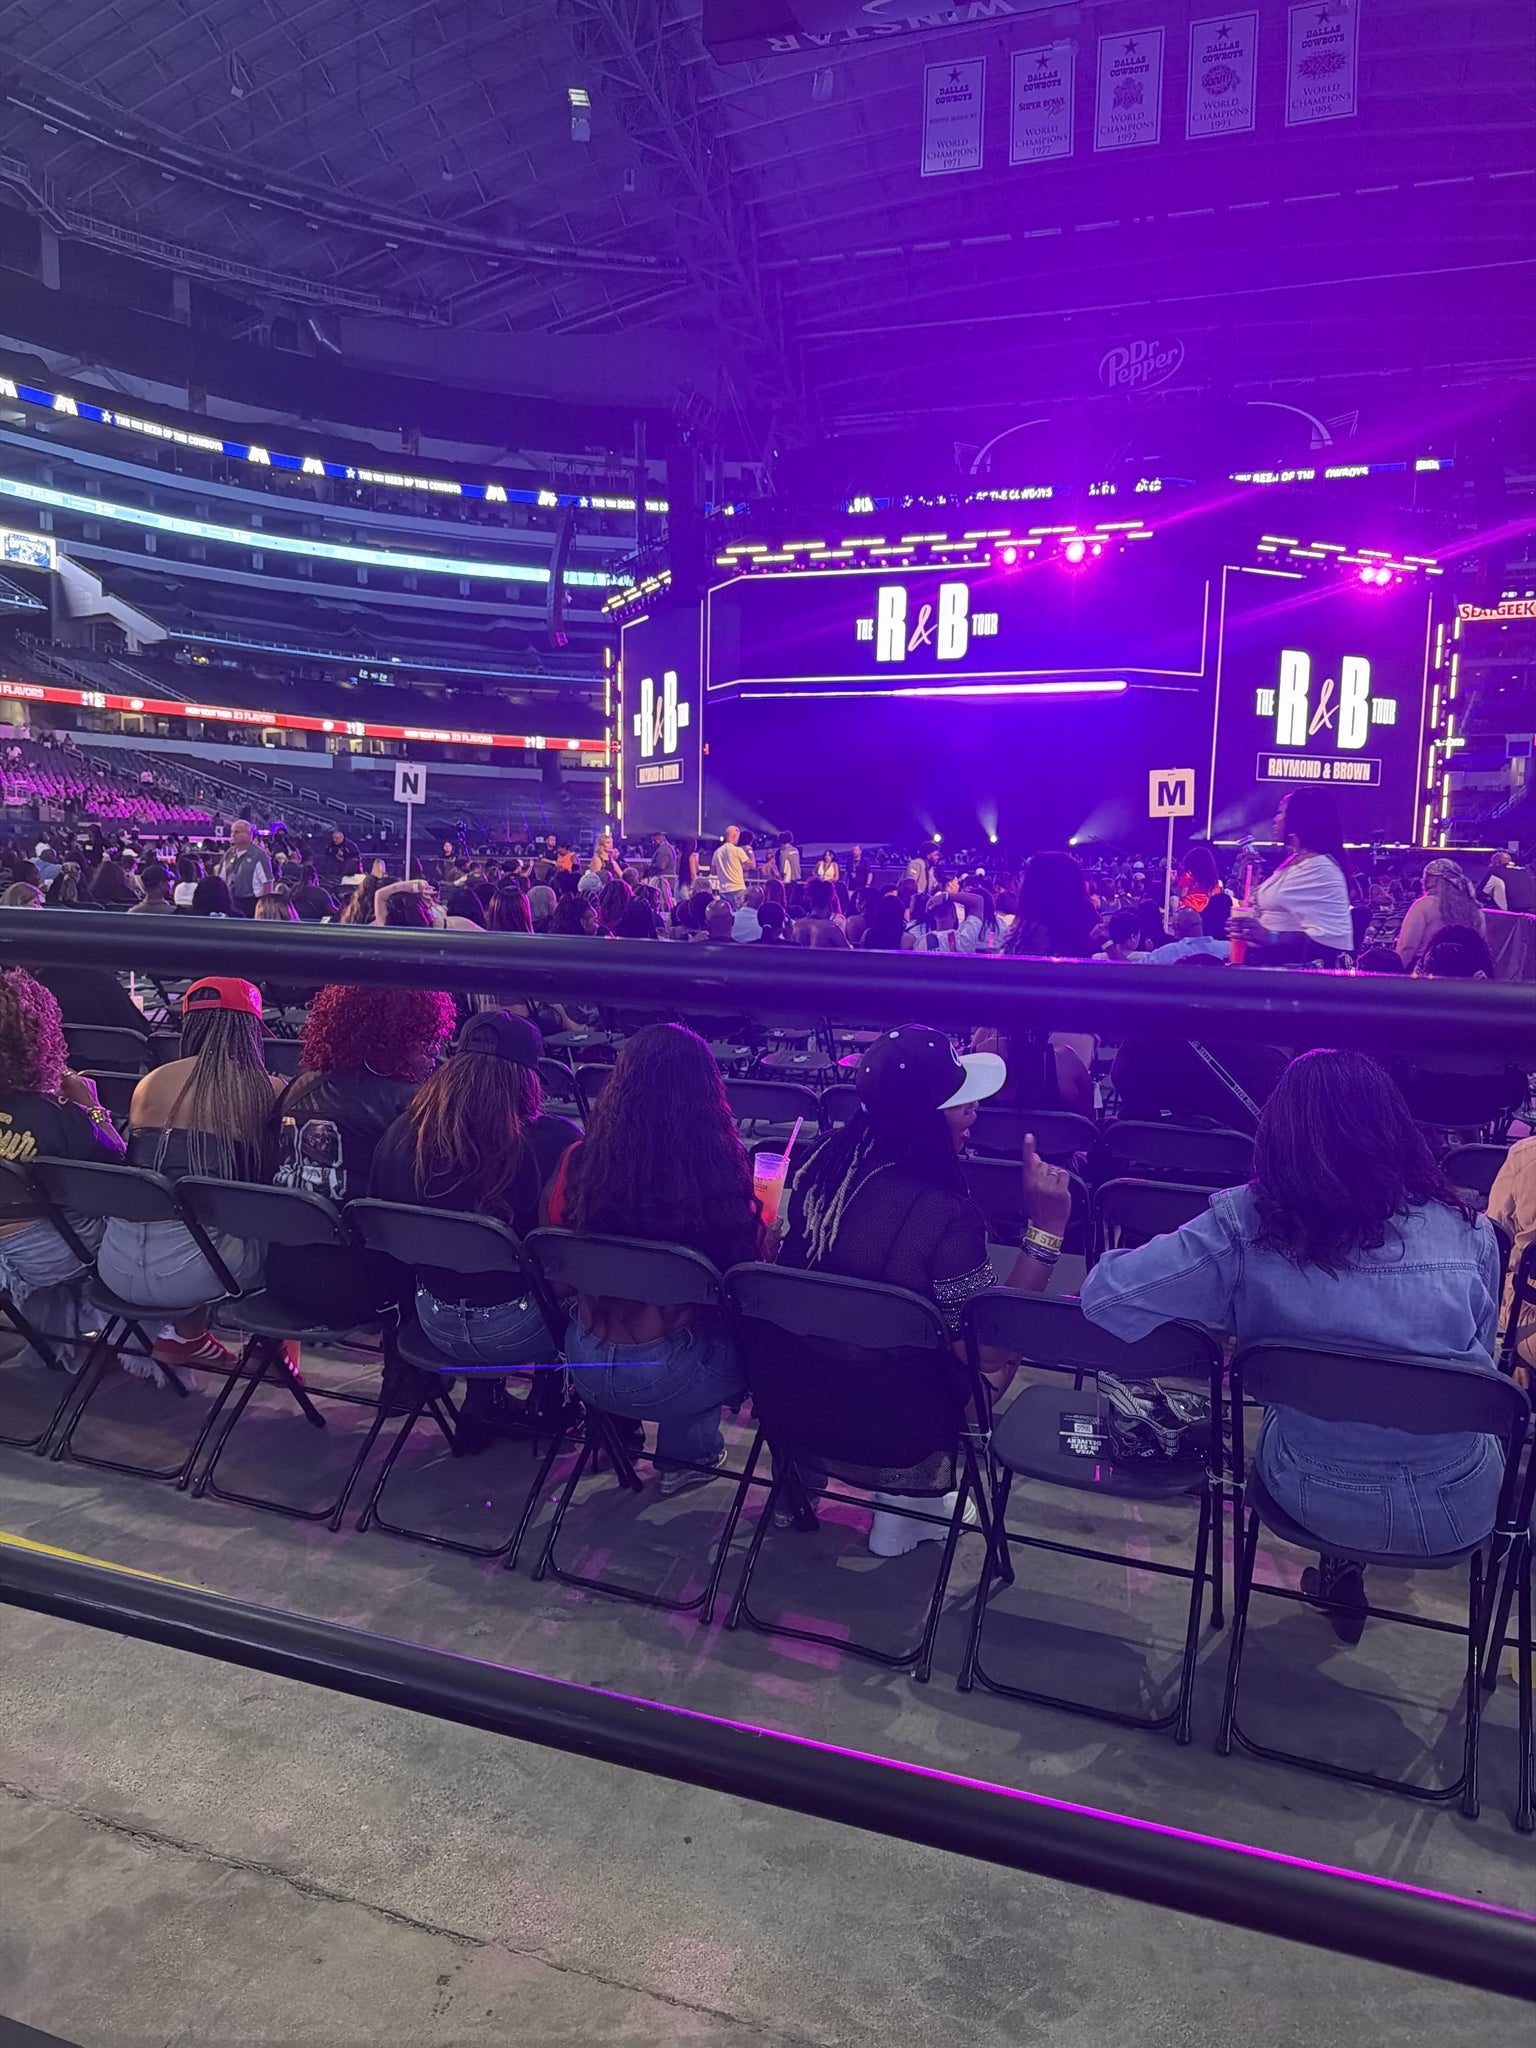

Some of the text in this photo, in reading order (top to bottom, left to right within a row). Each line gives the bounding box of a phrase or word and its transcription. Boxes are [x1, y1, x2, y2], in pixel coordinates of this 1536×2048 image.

[1306, 25, 1341, 38] DALLAS
[1207, 41, 1240, 54] DALLAS
[1301, 34, 1345, 48] COWBOYS
[1114, 56, 1146, 68] DALLAS
[1202, 49, 1244, 64] COWBOYS
[1027, 70, 1058, 82] DALLAS
[1110, 65, 1150, 77] COWBOYS
[939, 84, 969, 96] DALLAS
[1023, 79, 1062, 92] COWBOYS
[1303, 83, 1340, 95] WORLD
[935, 93, 973, 105] COWBOYS
[1203, 98, 1239, 110] WORLD
[1292, 92, 1351, 109] CHAMPIONS
[1192, 106, 1250, 121] CHAMPIONS
[1312, 105, 1332, 115] 1995
[1110, 112, 1145, 123] WORLD
[1025, 125, 1058, 137] WORLD
[1100, 120, 1155, 135] CHAMPIONS
[1210, 119, 1232, 130] 1993
[936, 139, 968, 149] WORLD
[1015, 135, 1068, 148] CHAMPIONS
[1117, 132, 1137, 143] 1992
[927, 148, 978, 160] CHAMPIONS
[943, 158, 961, 168] 1971
[1130, 340, 1159, 364] Dr
[1100, 347, 1178, 387] Pepper
[1461, 602, 1536, 619] SEATGEEK
[856, 619, 874, 640] THE
[972, 613, 998, 636] TOUR
[3, 684, 45, 698] FLAVORS
[1256, 688, 1275, 716] THE
[1371, 698, 1397, 725] TOUR
[1268, 758, 1371, 781] RAYMOND & BROWN
[401, 772, 419, 795] N
[1158, 780, 1186, 806] M
[1066, 1438, 1102, 1446] DELIVERY
